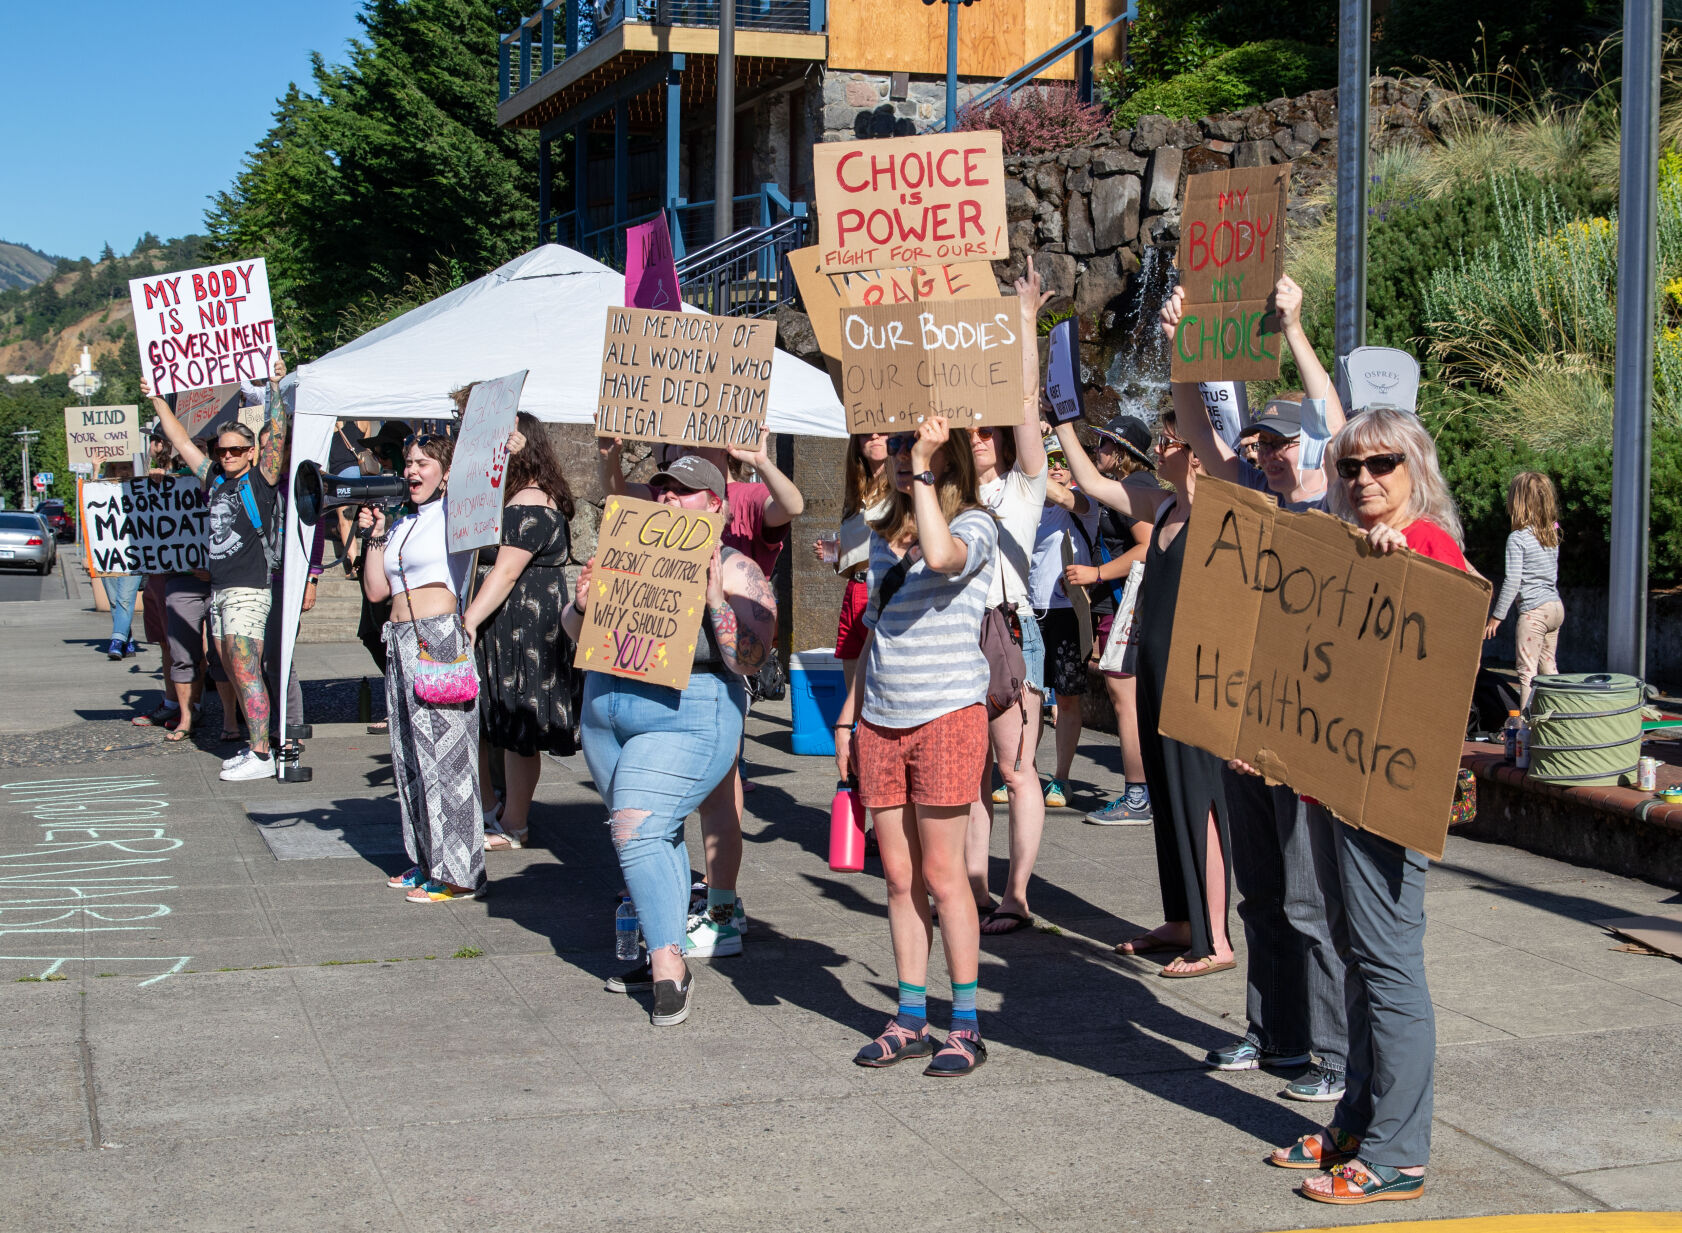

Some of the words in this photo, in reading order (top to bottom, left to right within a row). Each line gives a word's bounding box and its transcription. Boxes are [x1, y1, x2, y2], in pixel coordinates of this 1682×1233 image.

[836, 148, 989, 193] CHOICE
[900, 191, 923, 206] IS
[1217, 186, 1249, 213] MY
[837, 200, 986, 248] POWER
[1190, 212, 1273, 271] BODY
[825, 247, 880, 266] FIGHT
[890, 245, 931, 262] FOR
[937, 225, 1001, 258] OURS!
[143, 277, 181, 310] MY
[191, 264, 254, 301] BODY
[1211, 272, 1245, 303] MY
[159, 308, 184, 335] IS
[198, 296, 246, 329] NOT
[611, 313, 632, 335] IN
[643, 315, 724, 344] MEMORY
[732, 324, 760, 349] OF
[845, 314, 914, 350] OUR
[918, 312, 1016, 351] BODIES
[148, 319, 274, 366] GOVERNMENT
[1177, 311, 1277, 362] CHOICE
[152, 346, 273, 396] PROPERTY
[605, 342, 640, 366] ALL
[649, 345, 719, 374] WOMEN
[730, 356, 773, 381] WHO
[846, 364, 903, 394] OUR
[916, 360, 1008, 389] CHOICE
[1364, 370, 1400, 380] OSPREY
[600, 372, 652, 402] HAVE
[661, 377, 710, 408] DIED
[717, 383, 766, 414] FROM
[1202, 389, 1229, 402] TUS
[82, 409, 126, 426] MIND
[597, 405, 668, 437] ILLEGAL
[681, 411, 766, 445] ABORTION
[69, 432, 98, 444] YOUR
[104, 431, 128, 440] OWN
[130, 476, 176, 496] END
[95, 511, 210, 541] MANDAT
[610, 509, 638, 537] IF
[638, 509, 713, 552] GOD
[600, 547, 652, 573] DOESN'T
[651, 556, 701, 584] CONTROL
[1204, 508, 1428, 661] Abortion
[609, 577, 638, 606] MY
[632, 582, 682, 616] CHOICES,
[593, 601, 629, 631] WHY
[627, 611, 678, 639] SHOULD
[613, 629, 655, 672] YOU.
[1302, 622, 1335, 682] is
[1194, 643, 1417, 791] Healthcare
